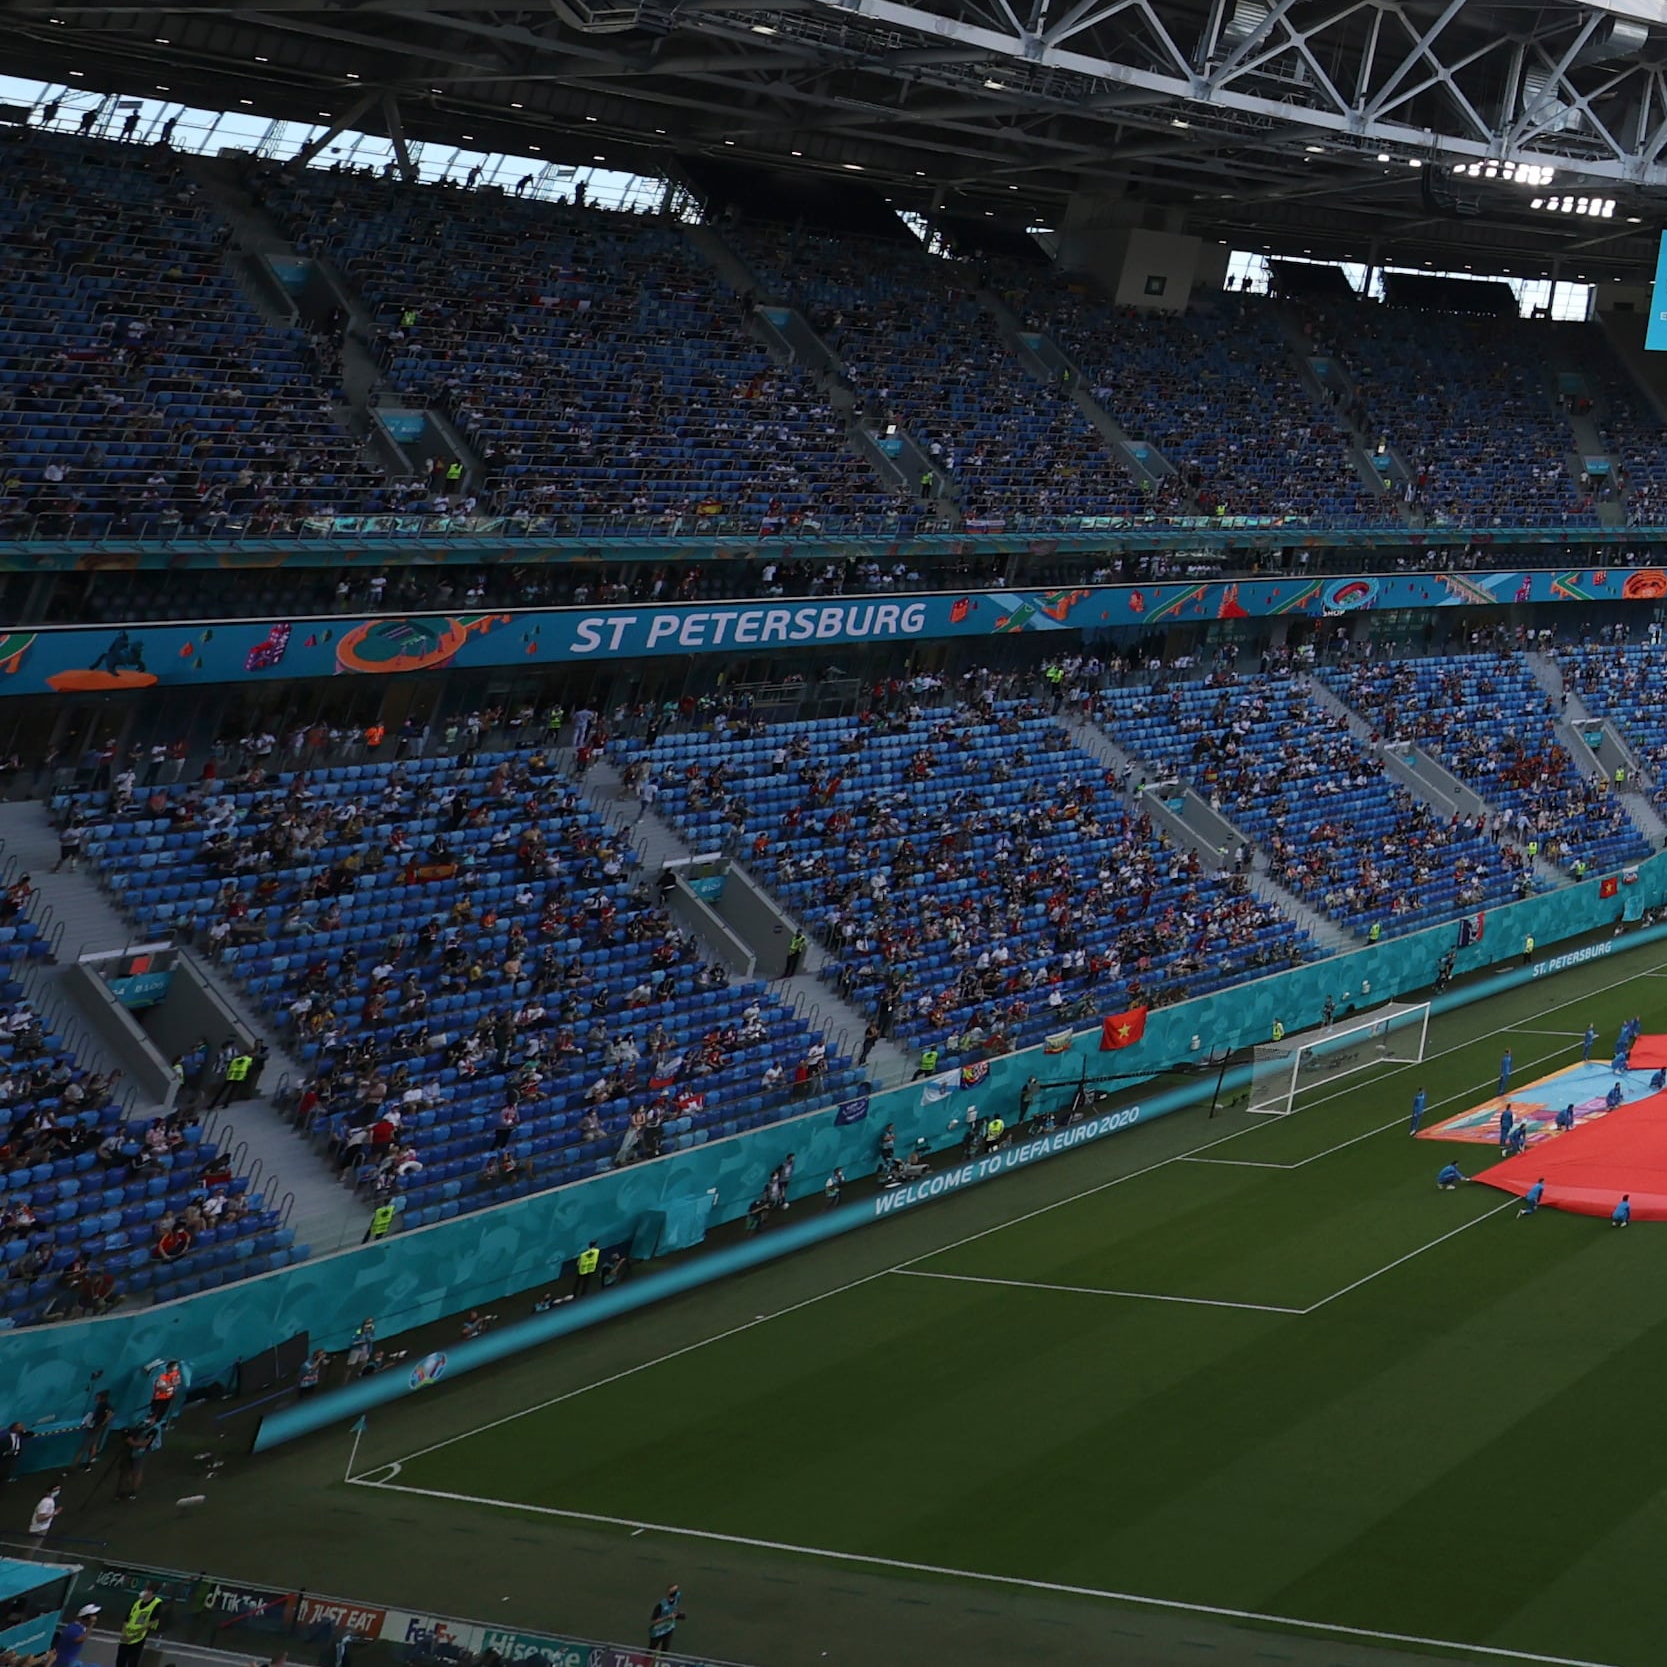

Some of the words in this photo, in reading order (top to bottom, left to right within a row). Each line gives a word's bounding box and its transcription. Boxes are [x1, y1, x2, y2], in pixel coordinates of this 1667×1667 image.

[569, 617, 638, 653] ST
[645, 603, 927, 649] PETERSBURG
[1532, 963, 1546, 977] ST.
[1549, 941, 1612, 971] PETERSBURG
[875, 1165, 974, 1215] WELCOME
[979, 1155, 1001, 1178] TO
[1005, 1138, 1050, 1167] UEFA
[1052, 1124, 1098, 1152] EURO
[1098, 1106, 1140, 1134] 2020
[96, 1571, 125, 1586] UEFA
[309, 1605, 347, 1627] JUST
[347, 1611, 377, 1632] EAT
[405, 1618, 457, 1646] FeEx
